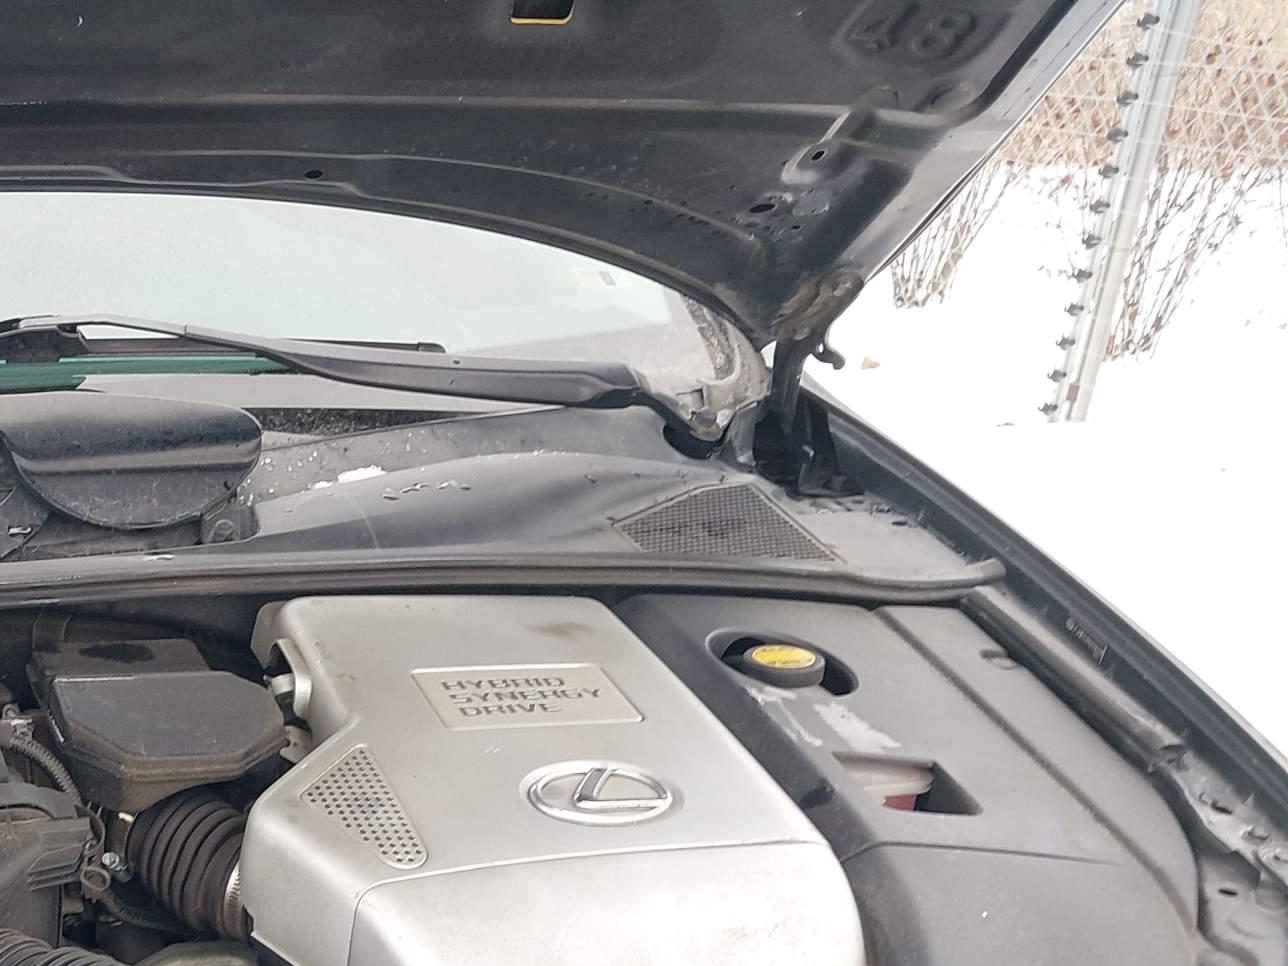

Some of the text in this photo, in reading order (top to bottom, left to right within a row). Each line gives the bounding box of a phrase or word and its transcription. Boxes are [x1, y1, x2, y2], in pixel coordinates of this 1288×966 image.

[440, 676, 566, 691] HYBRID
[448, 687, 601, 705] SYNERGY
[458, 702, 563, 718] DRIVE
